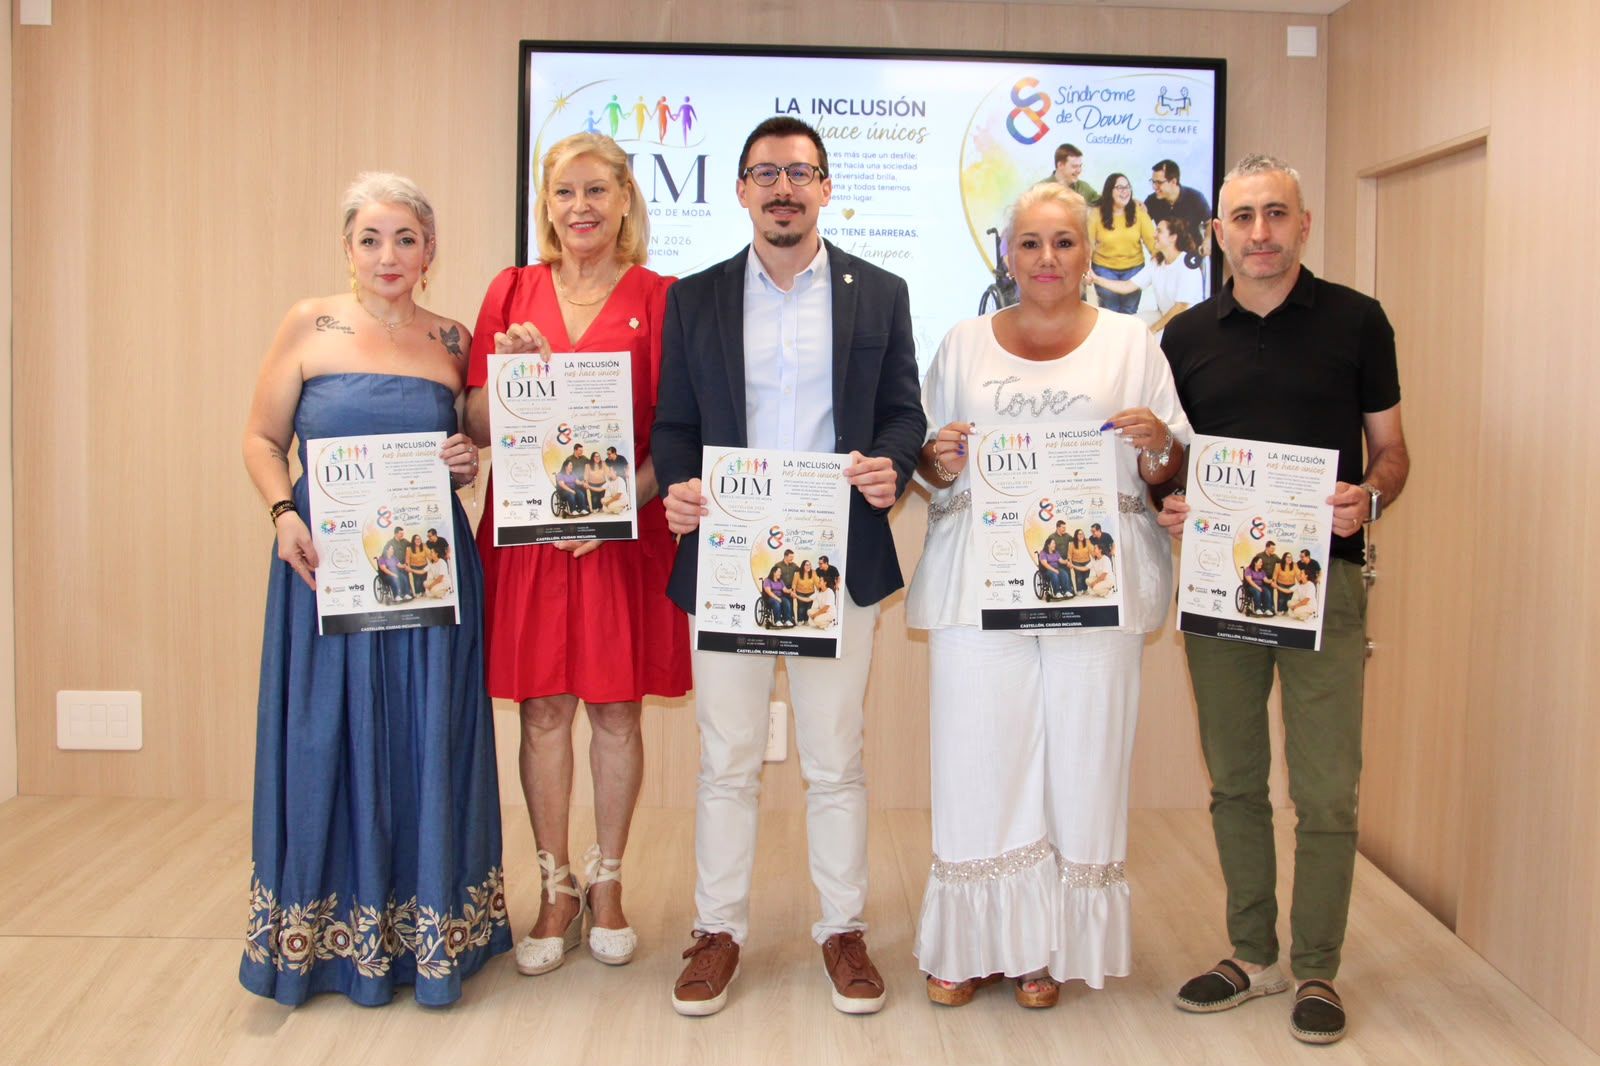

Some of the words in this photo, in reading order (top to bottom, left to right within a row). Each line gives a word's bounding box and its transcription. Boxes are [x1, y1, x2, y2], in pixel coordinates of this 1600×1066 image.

[1054, 84, 1136, 105] Síndrome
[775, 97, 800, 114] LA
[811, 95, 926, 117] INCLUSIÓN
[1056, 109, 1073, 124] de
[1075, 104, 1142, 131] Down
[815, 114, 861, 140] hace
[866, 121, 930, 145] únicos
[1147, 123, 1198, 135] COCEMFE
[1085, 132, 1133, 145] Castellón
[882, 162, 918, 171] sociedad
[834, 172, 875, 181] diversidad
[854, 183, 876, 191] todos
[878, 184, 912, 192] tenemos
[665, 208, 678, 217] DE
[682, 208, 712, 217] MODA
[824, 227, 838, 236] NO
[841, 228, 867, 237] TIENE
[664, 235, 692, 246] 2026
[564, 361, 575, 369] LA
[577, 360, 620, 369] INCLUSIÓN
[505, 380, 557, 399] DIM
[520, 435, 537, 444] ADI
[1045, 431, 1056, 440] LA
[1058, 429, 1102, 439] INCLUSIÓN
[382, 442, 393, 450] LA
[395, 440, 437, 449] INCLUSIÓN
[986, 452, 1038, 472] DIM
[1267, 451, 1278, 460] LA
[1281, 453, 1326, 465] INCLUSIÓN
[783, 460, 794, 468] LA
[796, 461, 841, 470] INCLUSIÓN
[324, 462, 376, 483] DIM
[1205, 464, 1257, 488] DIM
[719, 476, 772, 497] DIM
[526, 497, 542, 506] wbg
[1001, 512, 1019, 521] ADI
[340, 520, 358, 529] ADI
[1213, 523, 1231, 533] ADI
[728, 535, 747, 545] ADI
[1008, 577, 1024, 587] wbg
[349, 583, 365, 592] wbg
[1211, 587, 1227, 597] wbg
[729, 602, 746, 612] wbg
